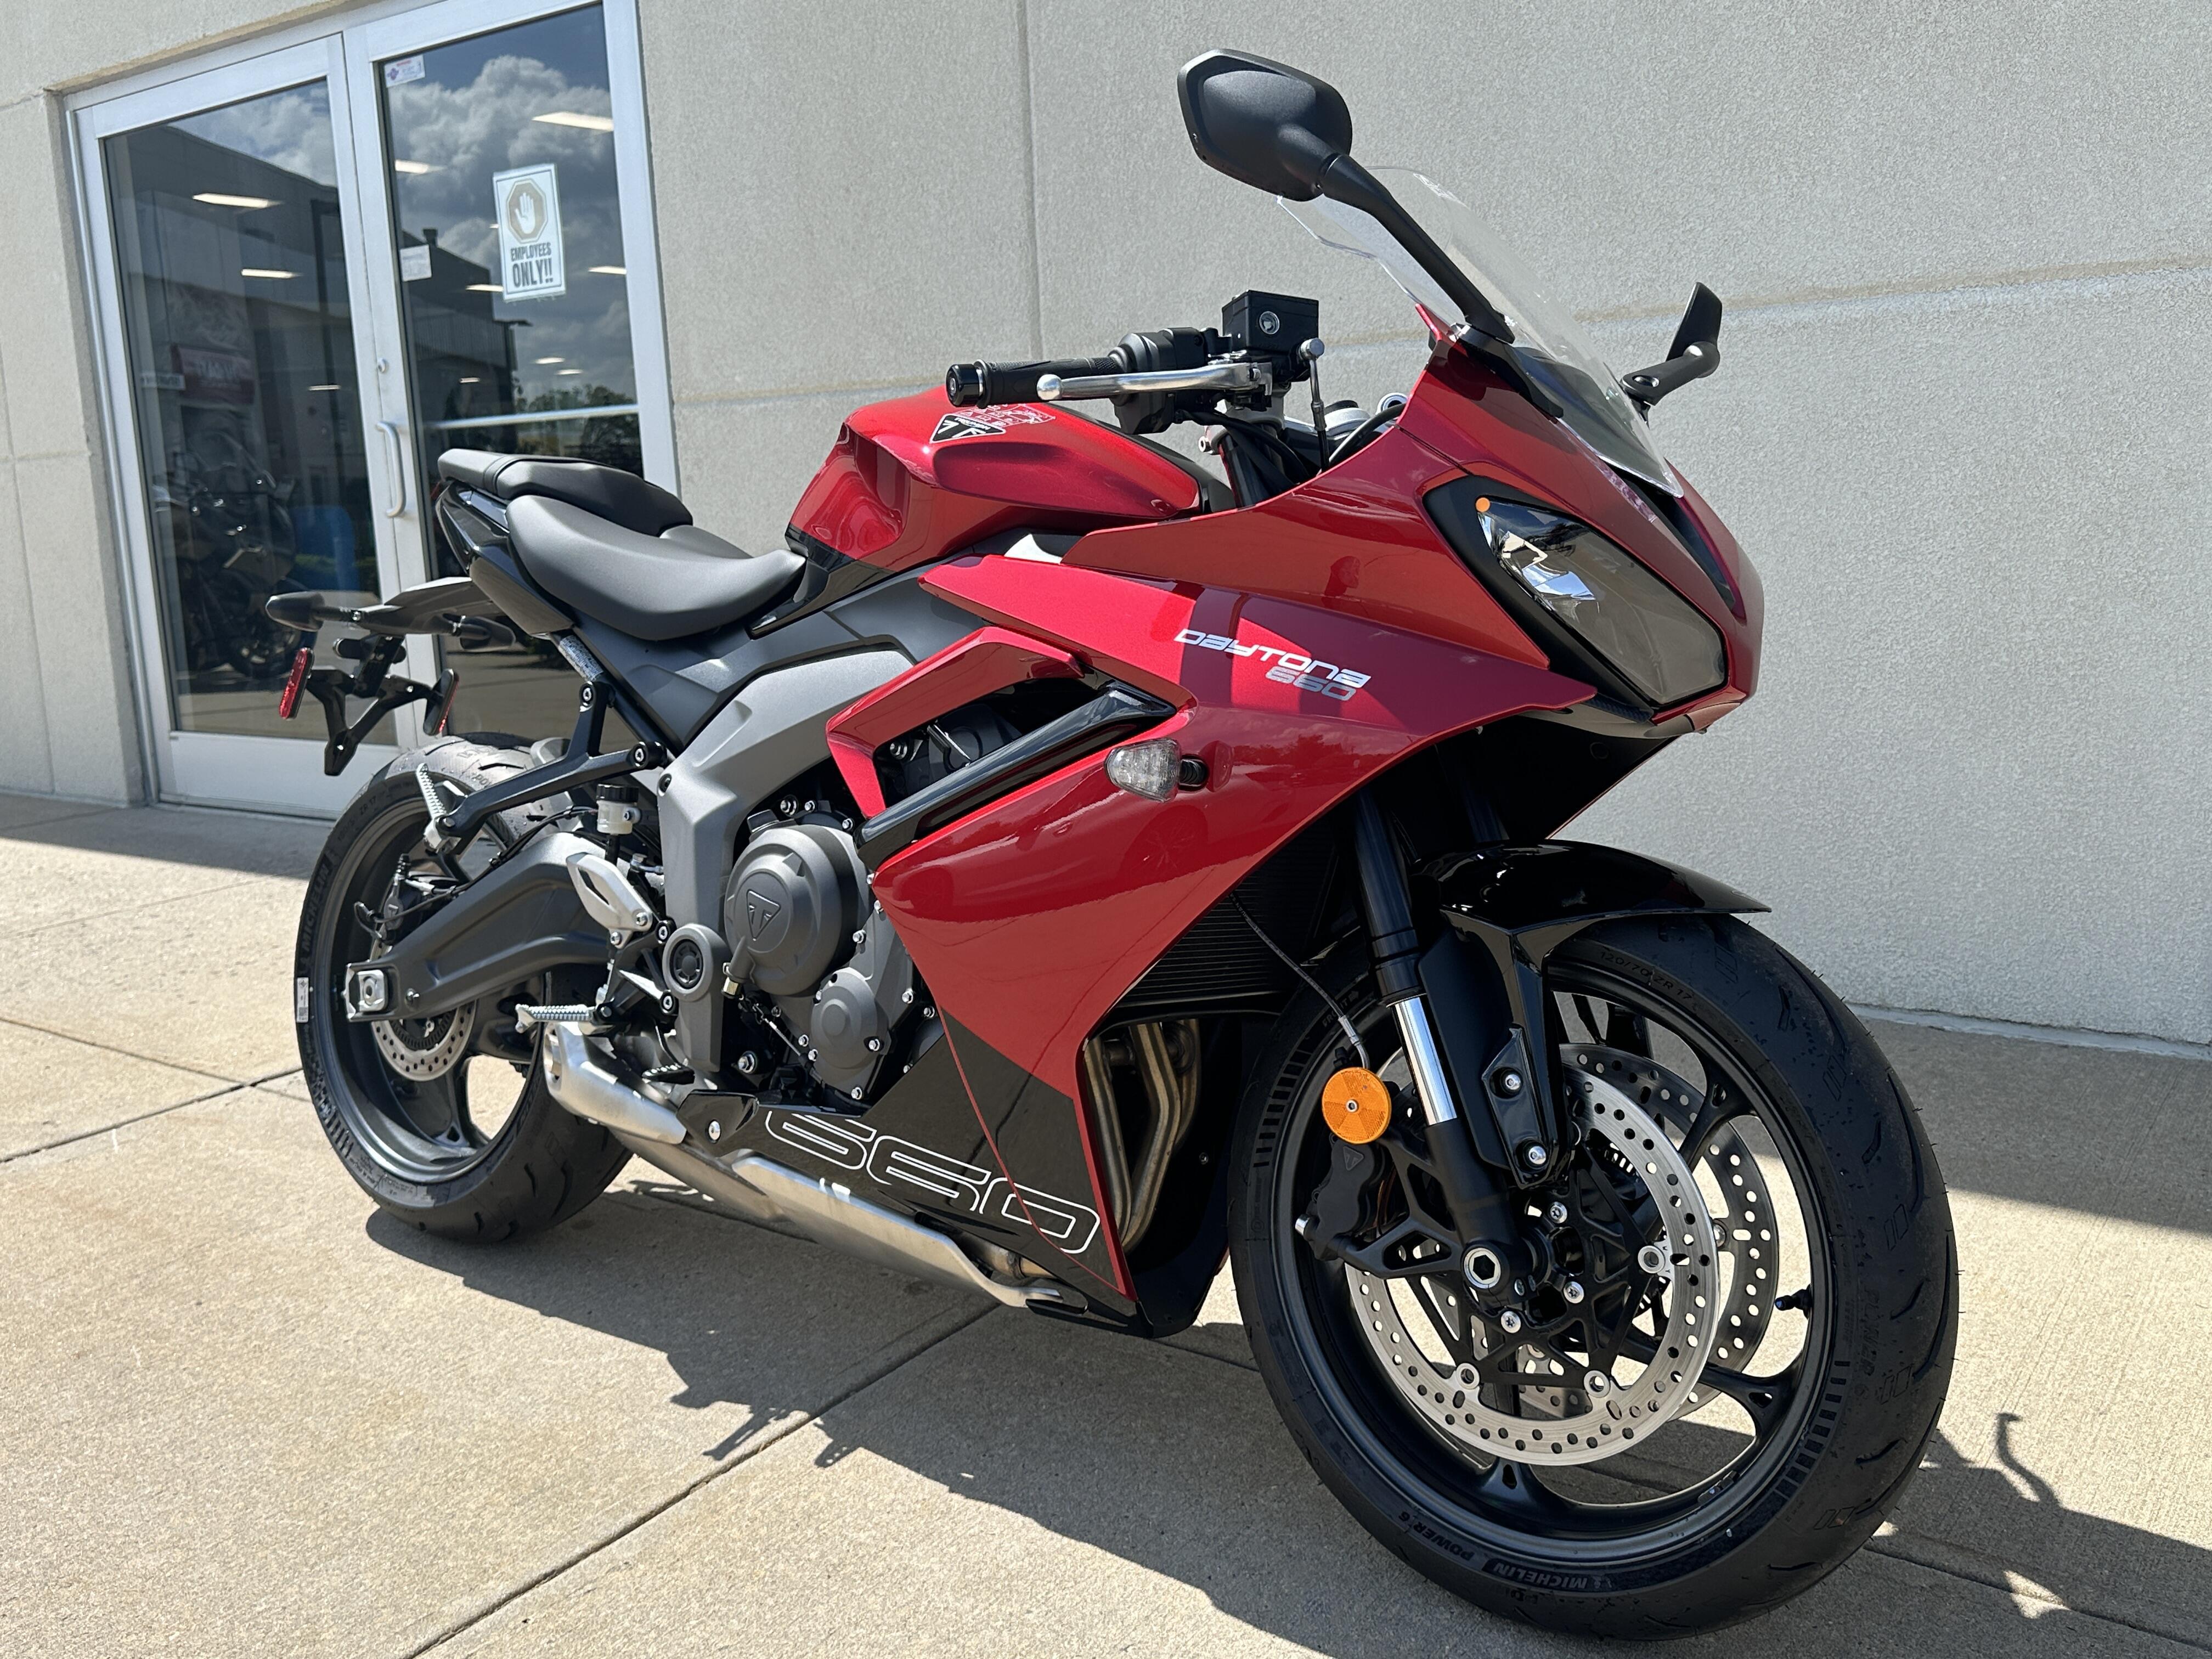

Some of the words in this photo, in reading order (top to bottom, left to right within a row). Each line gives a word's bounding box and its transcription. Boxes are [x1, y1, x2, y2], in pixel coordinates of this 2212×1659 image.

[510, 242, 551, 262] EMPLOYEES
[512, 258, 553, 287] ONLY!!
[955, 417, 991, 430] TRIUMPH
[1265, 665, 1357, 701] 660
[302, 863, 329, 952] MICHELIN
[1600, 952, 1651, 977] 120/70
[1654, 975, 1673, 989] ZR
[1677, 989, 1692, 1000] 17
[765, 1110, 1100, 1254] 660
[1398, 1511, 1410, 1522] 6
[1413, 1521, 1475, 1561] POWER
[1493, 1562, 1588, 1589] MICHELIN
